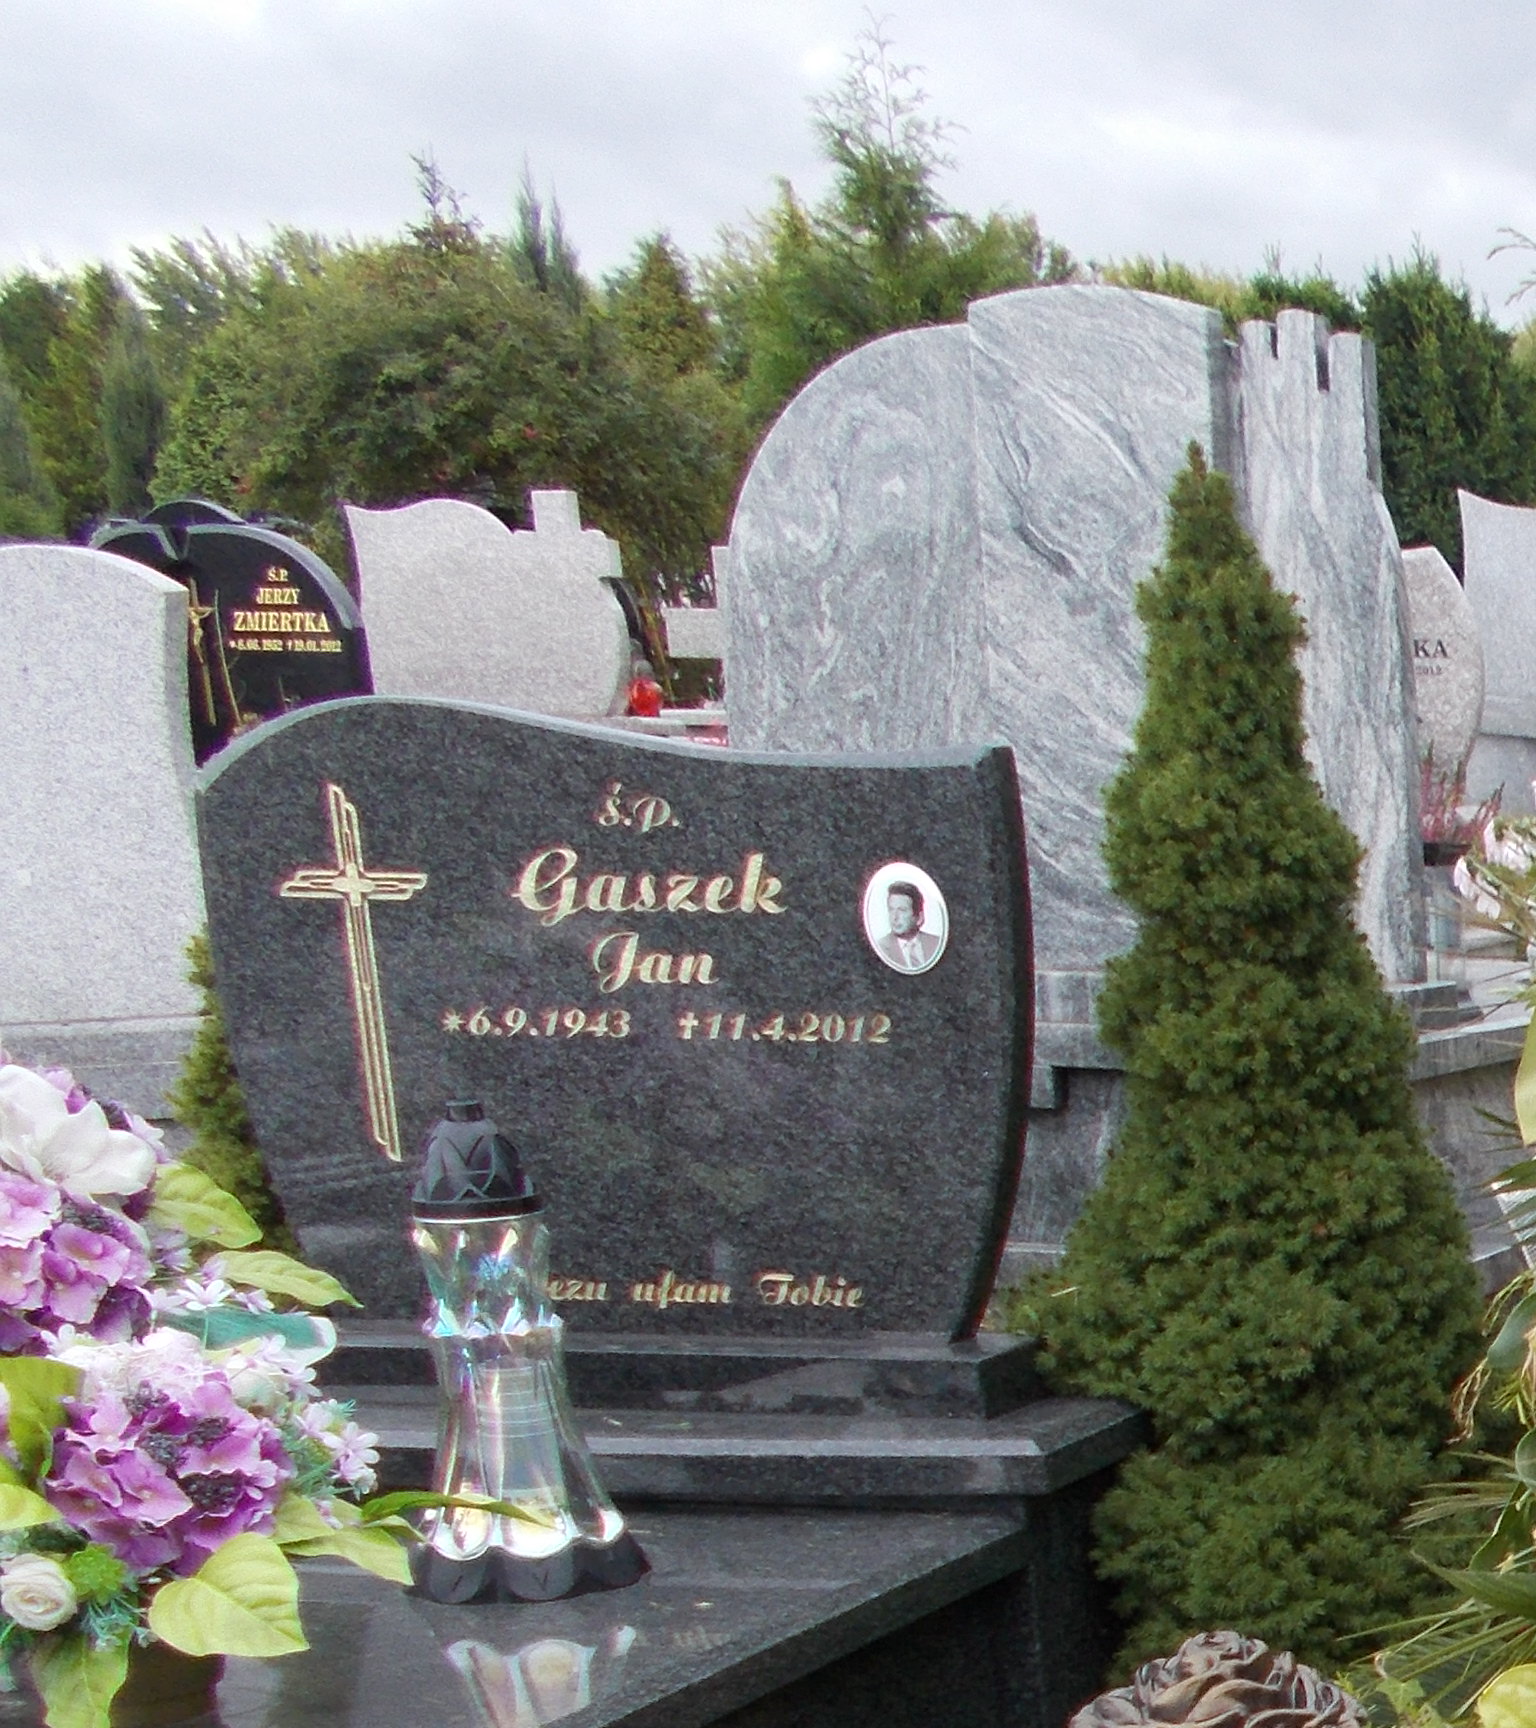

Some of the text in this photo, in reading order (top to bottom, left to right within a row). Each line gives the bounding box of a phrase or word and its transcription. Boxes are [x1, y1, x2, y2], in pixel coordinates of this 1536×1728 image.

[256, 587, 300, 605] JERZY
[233, 611, 331, 633] ZMIERTKA
[511, 847, 788, 927] Gaszek
[592, 932, 720, 994] Jan
[545, 1268, 864, 1309] ezu ufam Tobie
